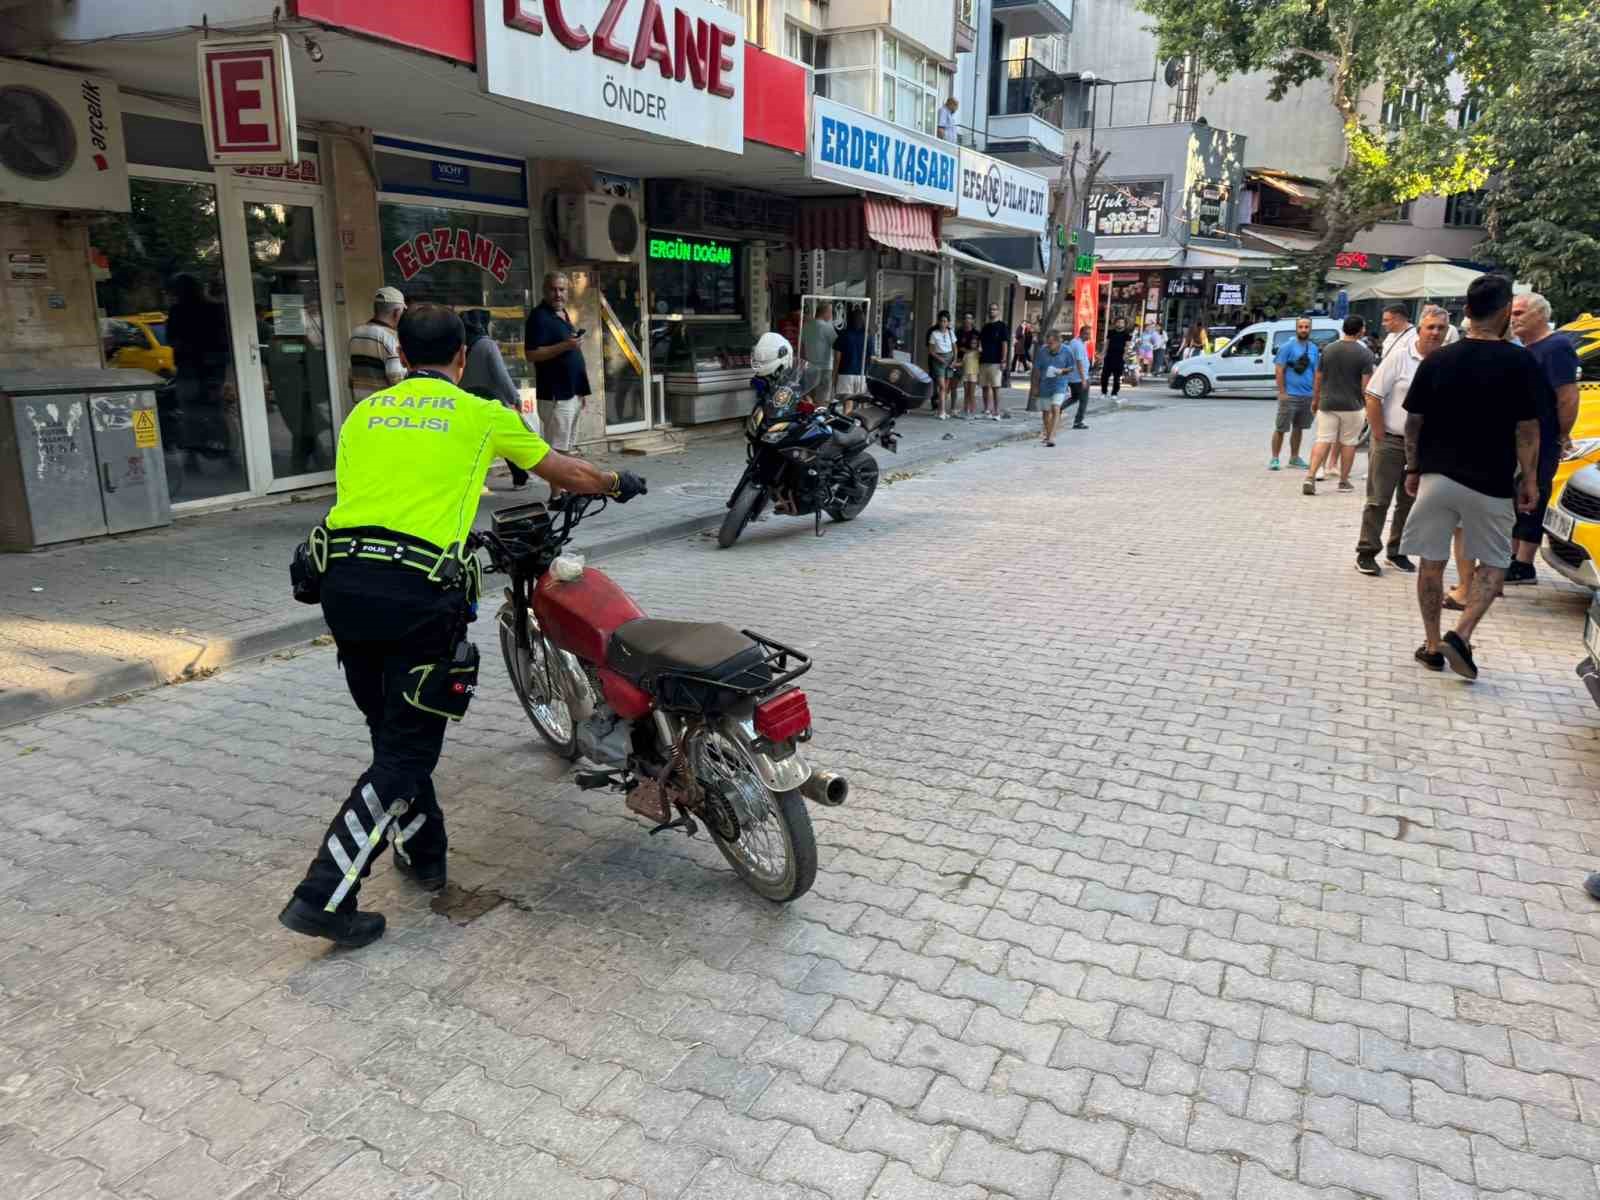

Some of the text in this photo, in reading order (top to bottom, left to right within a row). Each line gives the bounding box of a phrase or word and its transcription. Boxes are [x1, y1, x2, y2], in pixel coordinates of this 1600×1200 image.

[81, 79, 107, 151] arçelik
[218, 60, 270, 144] E
[602, 74, 667, 121] ÖNDER
[820, 116, 955, 193] ERDEK KASABI
[963, 168, 999, 205] EFSANE
[1002, 175, 1029, 213] PİLAV
[393, 227, 513, 285] ECZANE
[650, 237, 732, 265] ERGÜN DOĞAN
[367, 416, 449, 433] POLİSİ
